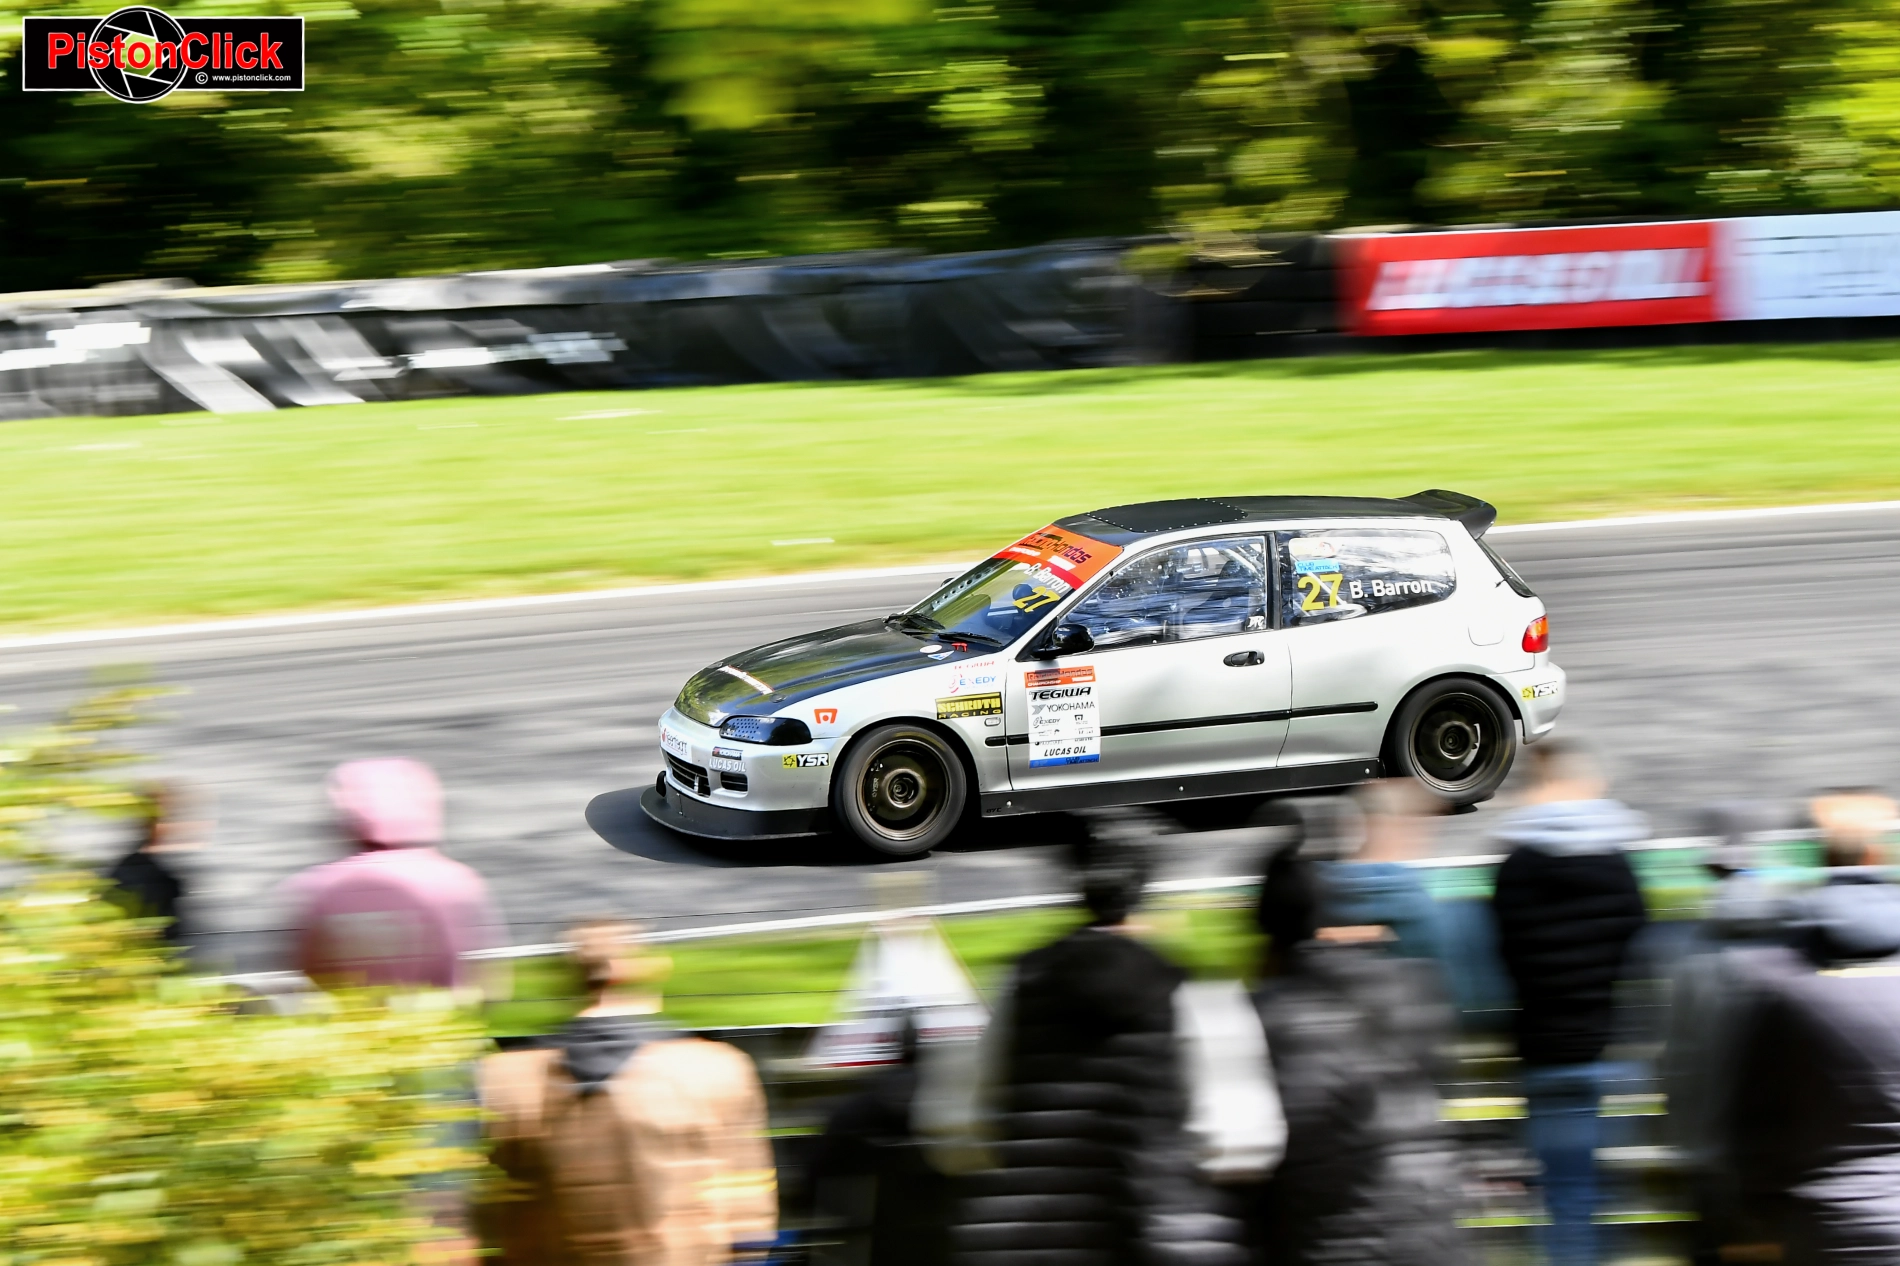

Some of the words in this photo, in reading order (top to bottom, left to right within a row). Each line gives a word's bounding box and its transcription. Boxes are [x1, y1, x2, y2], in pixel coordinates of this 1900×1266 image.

[1033, 567, 1071, 594] Barron
[1297, 573, 1344, 612] 27
[1349, 581, 1369, 599] B.
[1372, 579, 1433, 597] Barron
[1012, 586, 1061, 613] 27
[1030, 687, 1092, 700] TEGIWA
[937, 697, 1001, 713] SCHROTH
[1046, 701, 1095, 713] YOKOHAMA
[938, 709, 1002, 719] RACING
[1044, 747, 1072, 757] LUCAS
[1073, 746, 1087, 754] OIL
[709, 758, 732, 770] LUCAS
[733, 761, 746, 772] OIL
[797, 753, 829, 767] YSR
